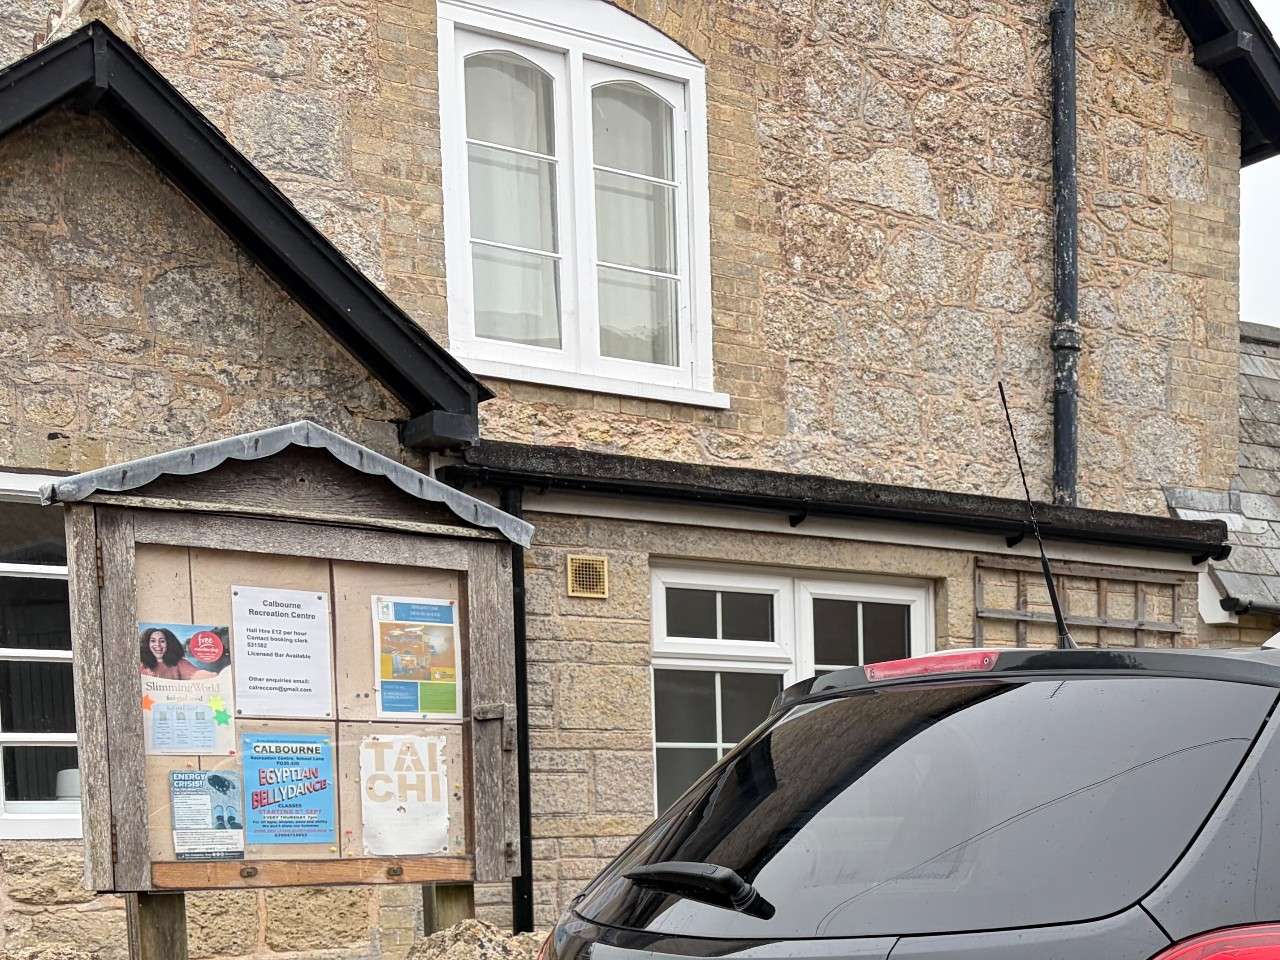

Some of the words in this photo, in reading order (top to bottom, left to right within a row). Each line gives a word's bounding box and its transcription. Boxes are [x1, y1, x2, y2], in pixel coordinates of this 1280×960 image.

[262, 599, 301, 609] Calbourne
[248, 608, 289, 618] Recreation
[291, 611, 316, 620] Centre
[253, 745, 321, 755] CALBOURNE
[365, 741, 437, 772] TAI
[258, 767, 320, 786] EGYPTIAN
[251, 779, 327, 810] BELLYDANCE
[366, 773, 441, 803] CHI
